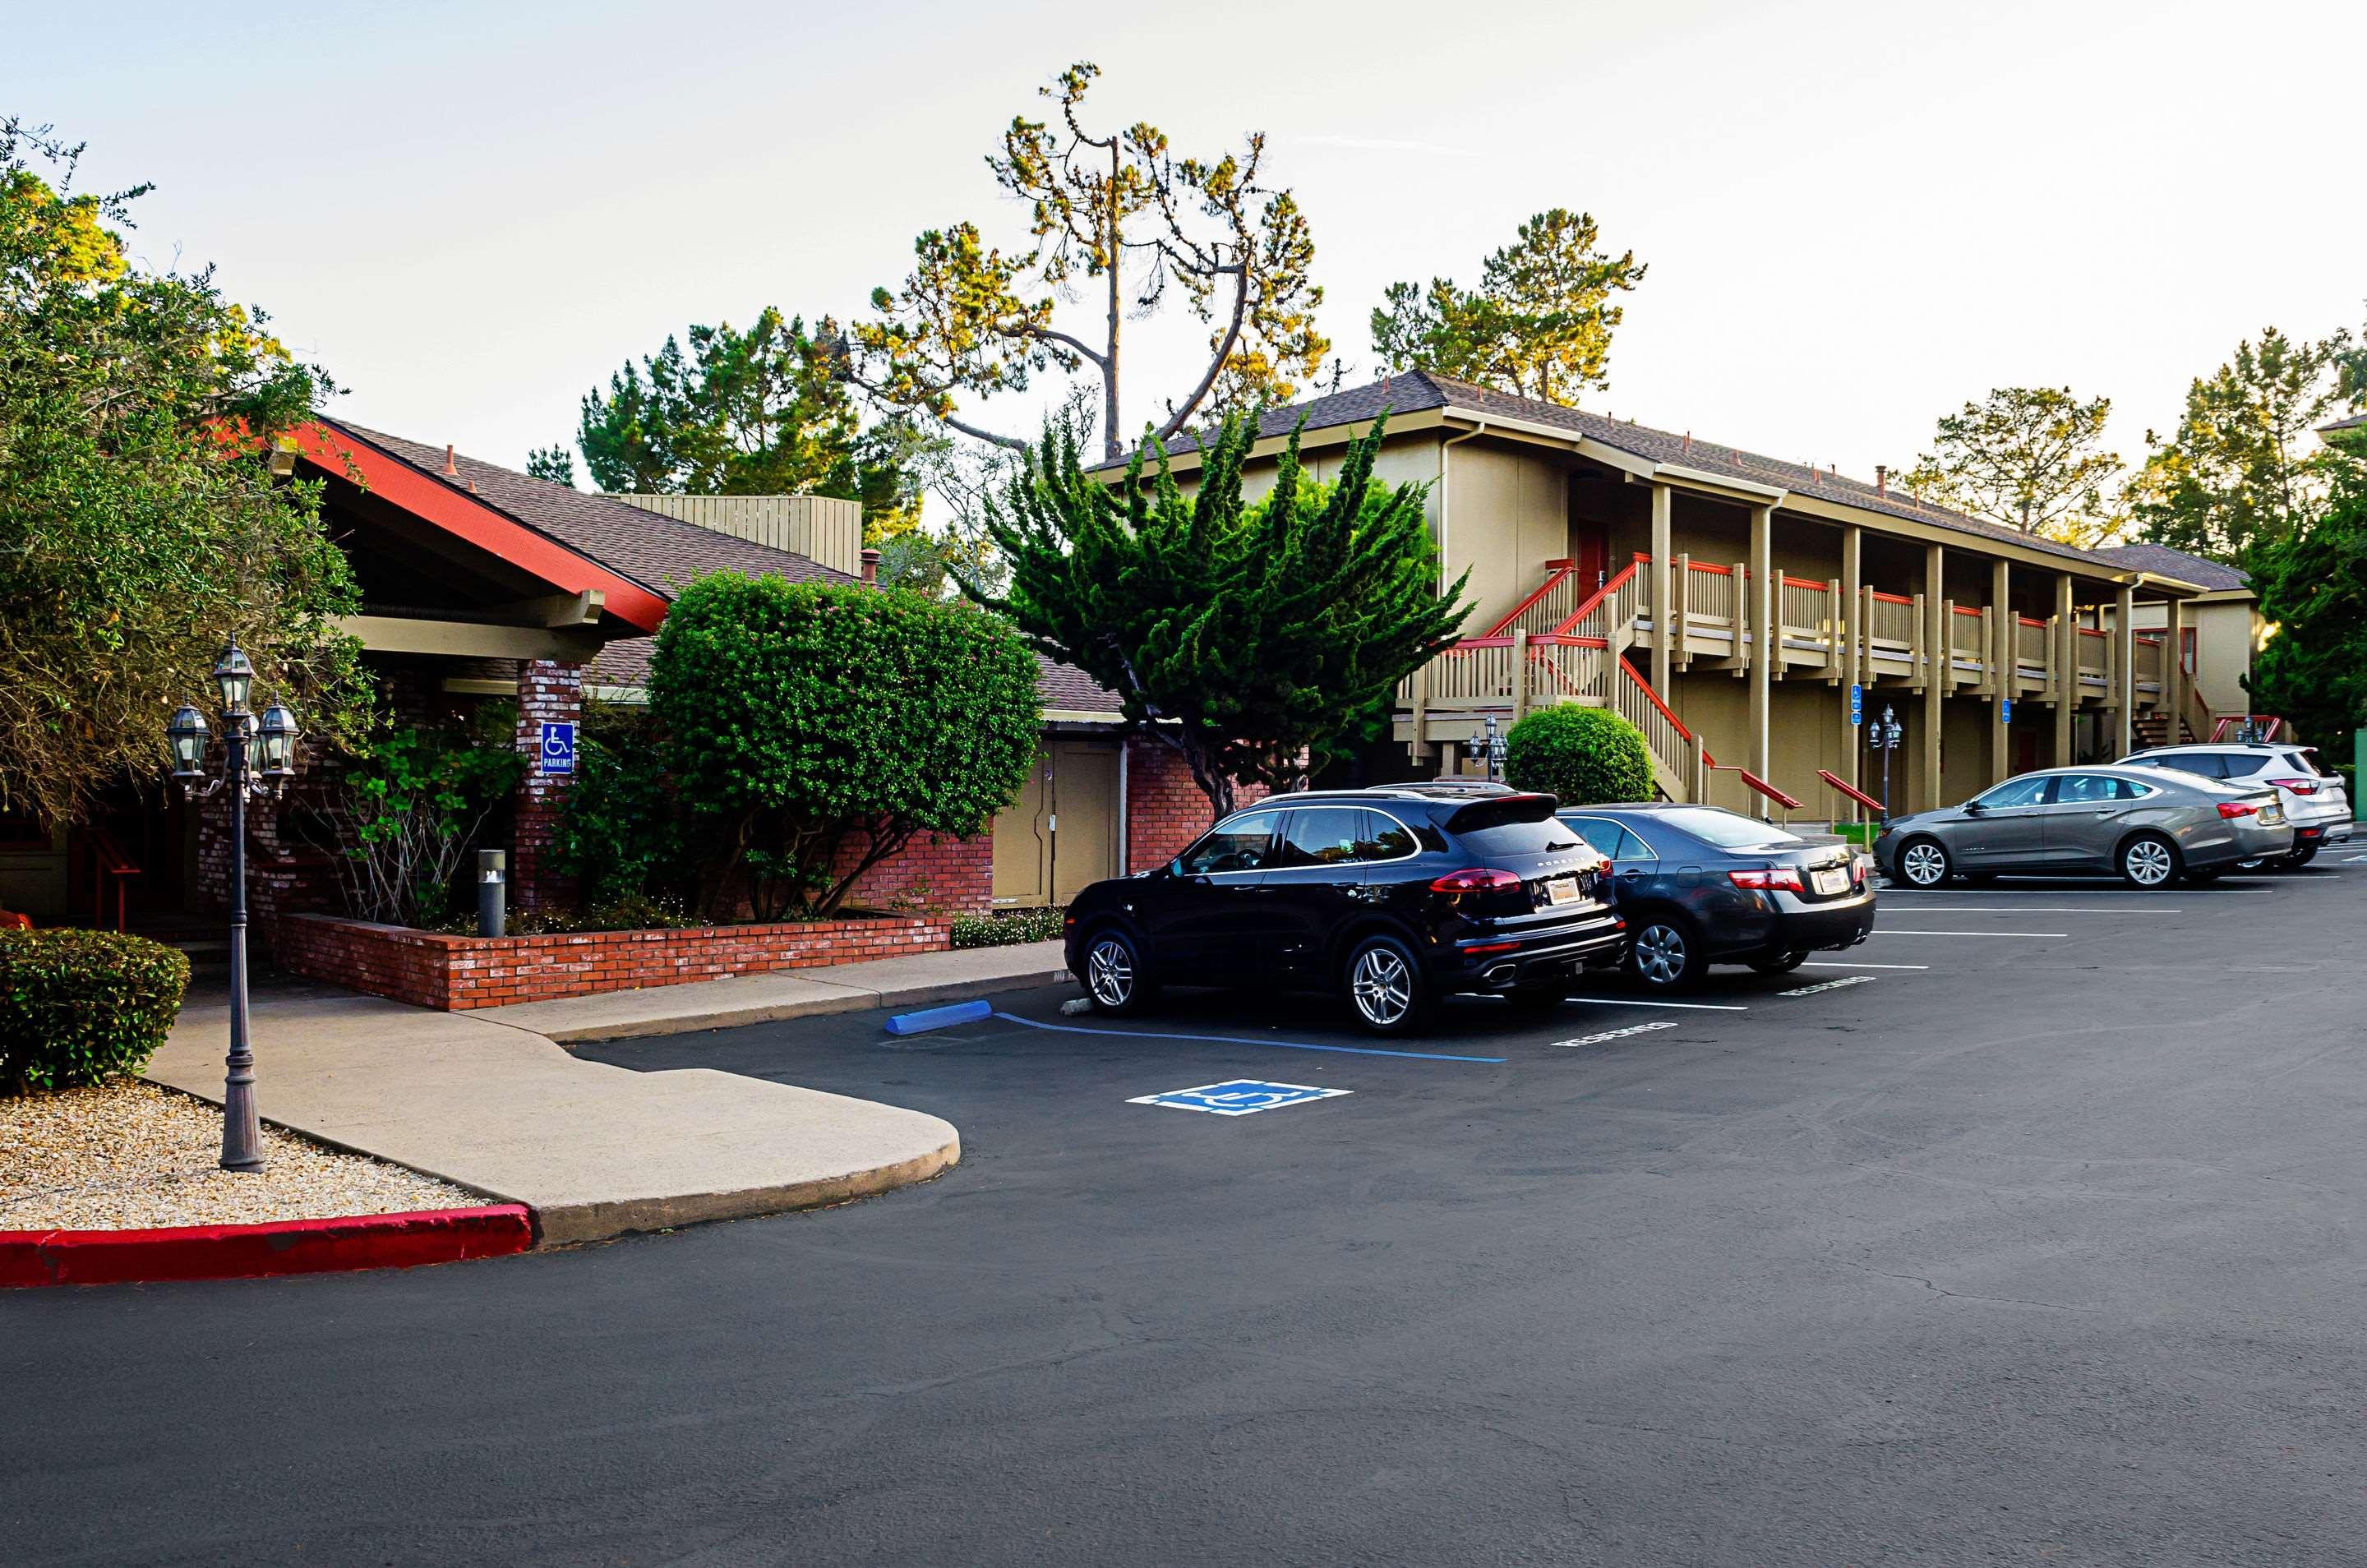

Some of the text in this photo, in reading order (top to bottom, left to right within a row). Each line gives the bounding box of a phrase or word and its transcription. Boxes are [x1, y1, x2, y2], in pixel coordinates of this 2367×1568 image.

[544, 758, 571, 768] PARKING
[1537, 856, 1585, 867] PORSCHE
[1549, 1022, 1679, 1047] RESERVED
